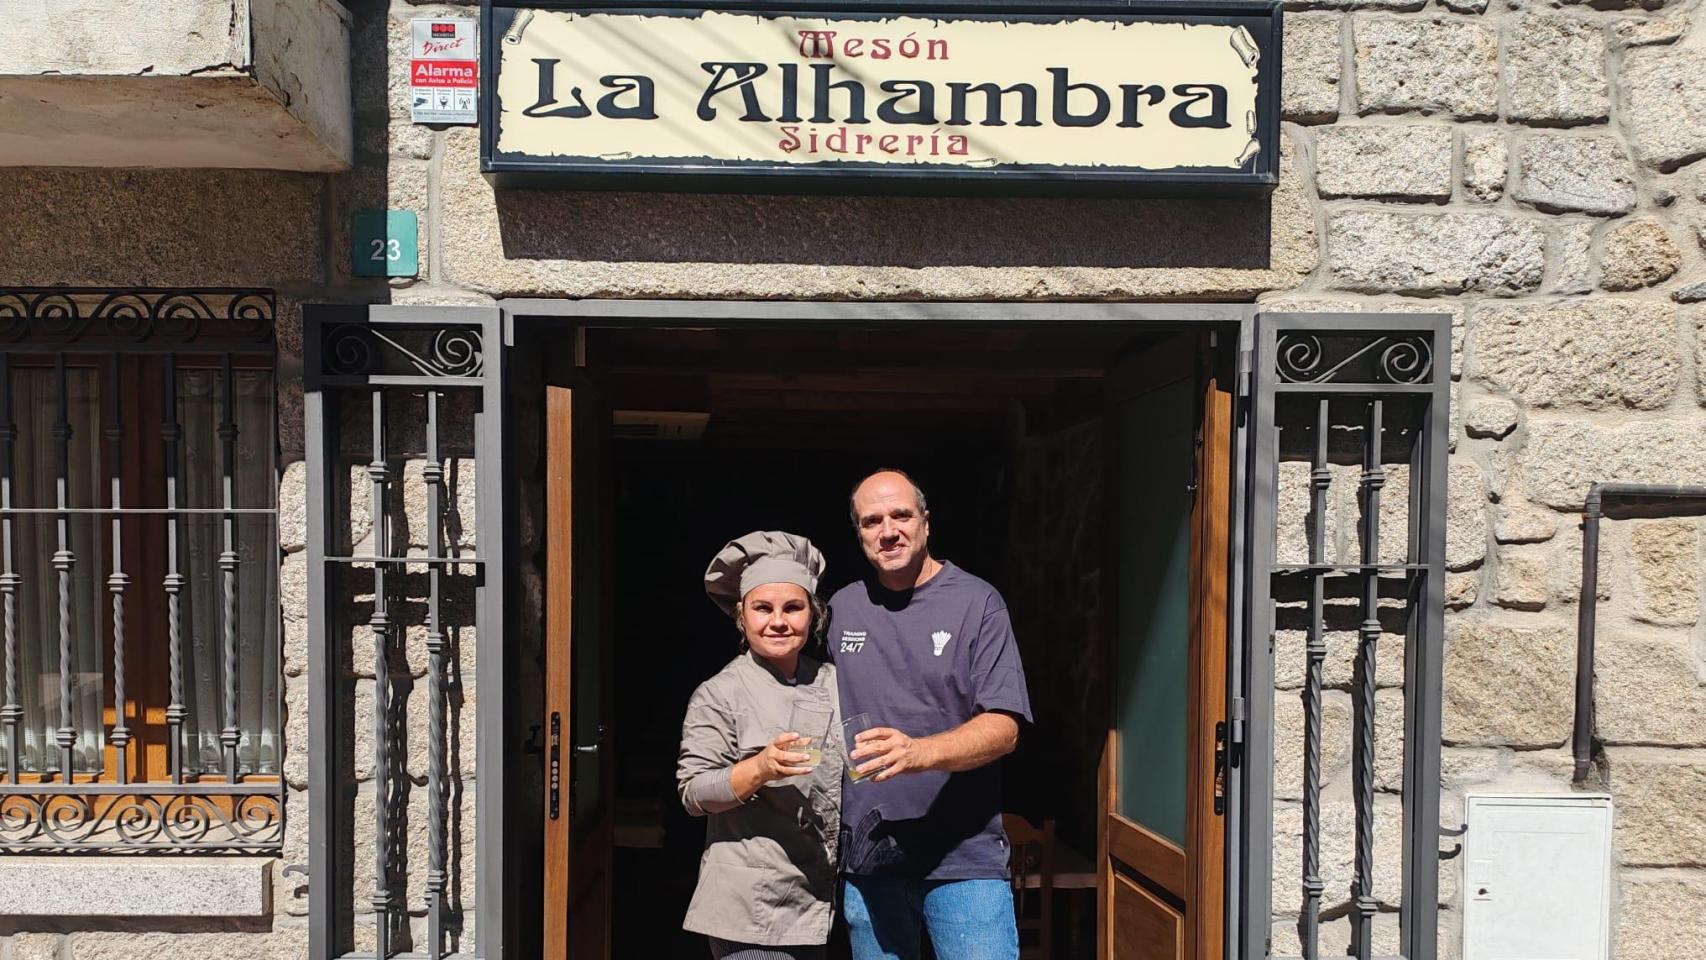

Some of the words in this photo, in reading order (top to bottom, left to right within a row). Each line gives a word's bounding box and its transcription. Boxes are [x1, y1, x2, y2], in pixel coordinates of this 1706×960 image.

[423, 38, 466, 55] Direct
[798, 30, 950, 60] Mesón
[416, 63, 473, 77] Alarma
[522, 58, 660, 120] La
[697, 62, 1232, 129] Alhambra
[778, 126, 969, 155] Sidrería
[370, 238, 401, 261] 23
[840, 642, 864, 653] 24/7
